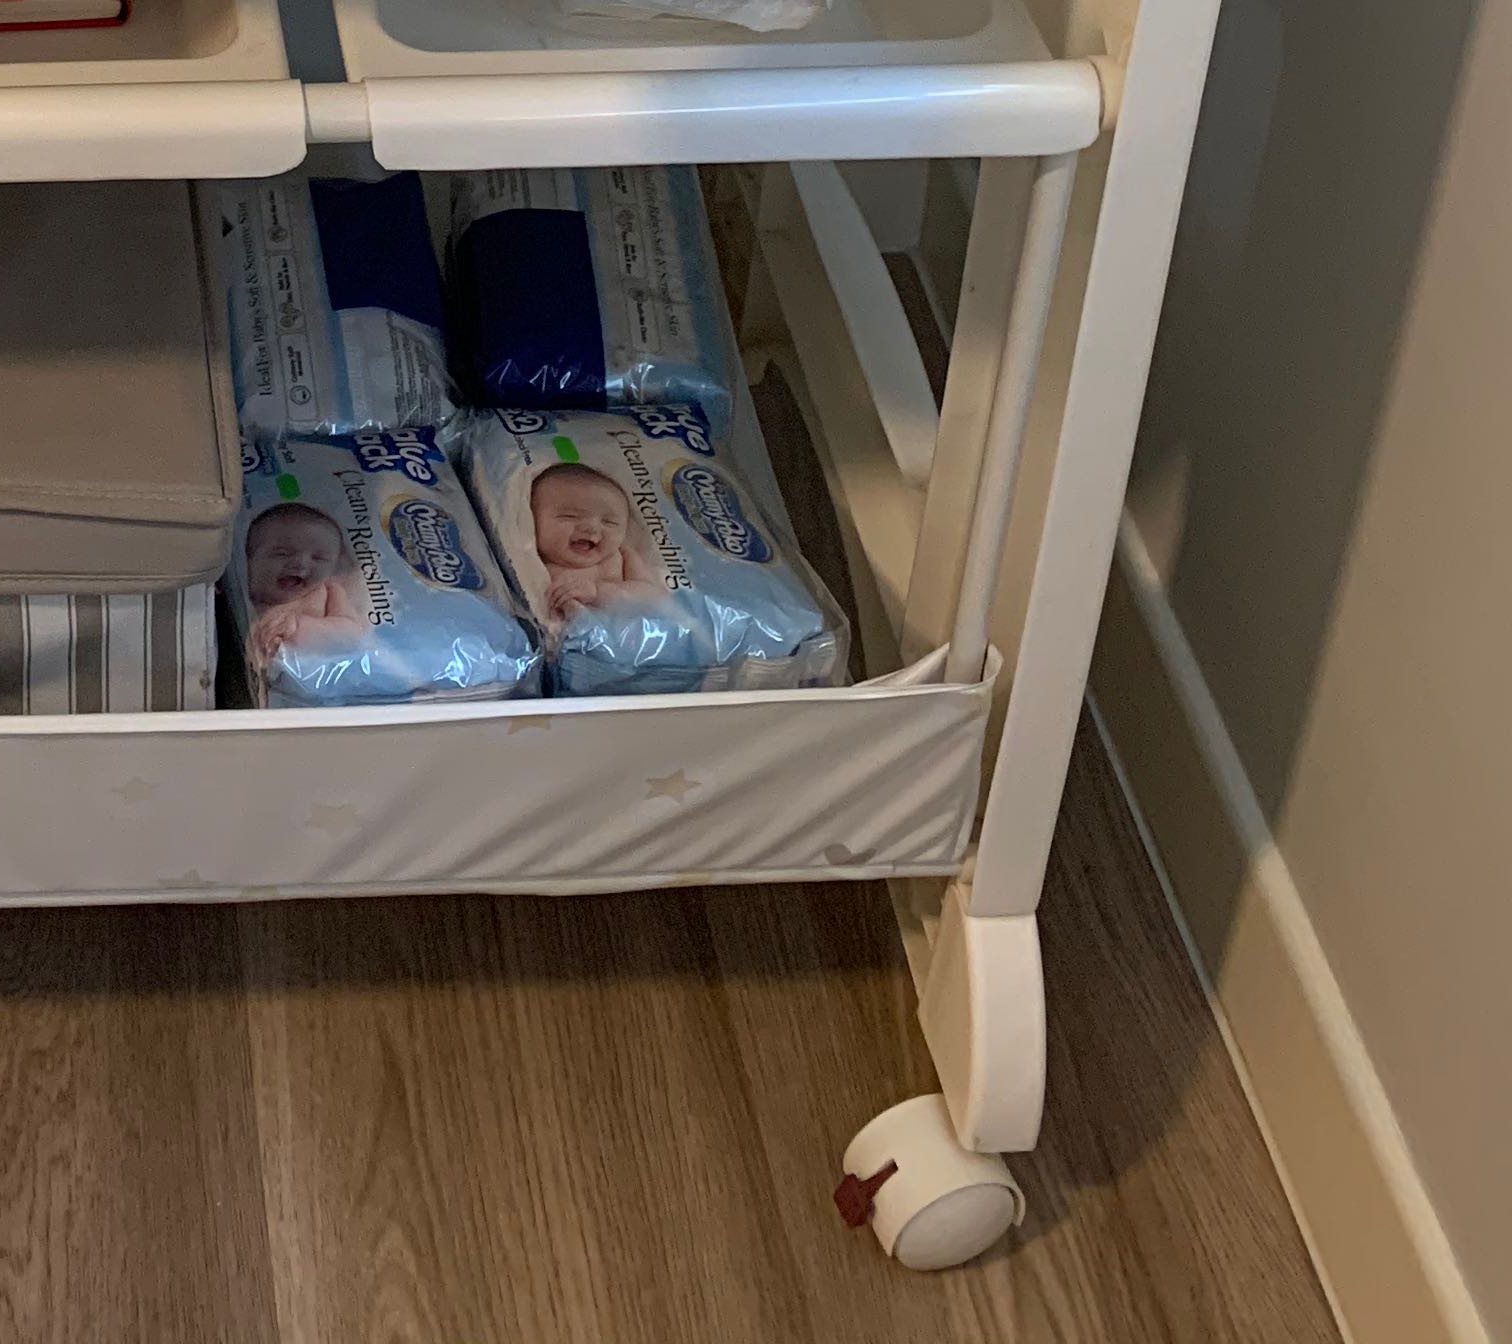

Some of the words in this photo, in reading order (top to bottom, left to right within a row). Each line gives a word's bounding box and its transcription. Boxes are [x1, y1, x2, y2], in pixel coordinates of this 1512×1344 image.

[354, 434, 401, 469] ack
[388, 427, 431, 480] alue
[334, 469, 368, 512] Clean
[607, 431, 648, 477] Clean
[632, 489, 693, 591] Refreshing
[348, 527, 395, 625] Refreshing
